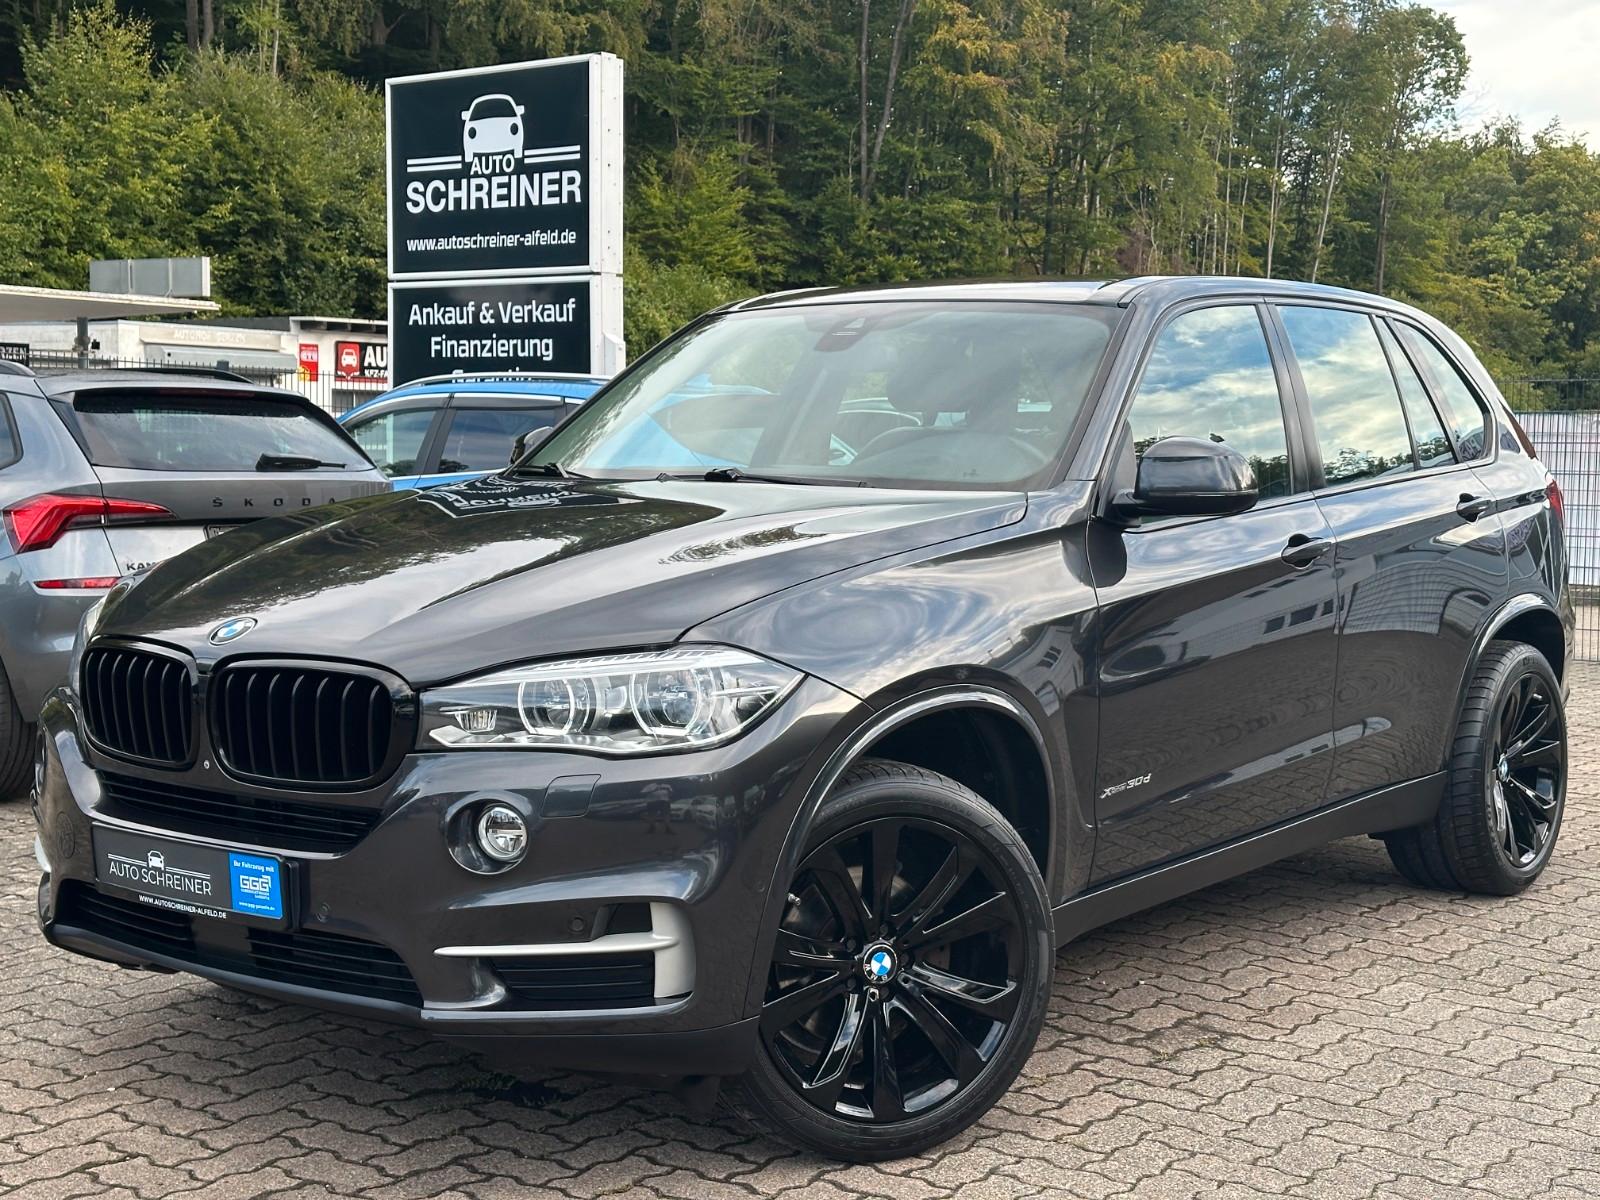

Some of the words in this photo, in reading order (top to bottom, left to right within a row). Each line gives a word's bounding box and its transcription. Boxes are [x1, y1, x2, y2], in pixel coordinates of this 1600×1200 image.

[470, 154, 515, 175] AUTO
[406, 170, 582, 214] SCHREINER
[407, 229, 576, 251] www.autoschreiner-alfeld.de
[409, 301, 475, 326] Ankauf
[479, 302, 495, 324] &
[498, 298, 576, 324] Verkauf
[430, 333, 553, 361] Finanzierung
[109, 861, 139, 880] AUTO
[141, 868, 212, 896] SCHREINER
[240, 875, 271, 893] GGG
[139, 895, 226, 919] WWW.AUTOSCHREINER-ALFELD.DE
